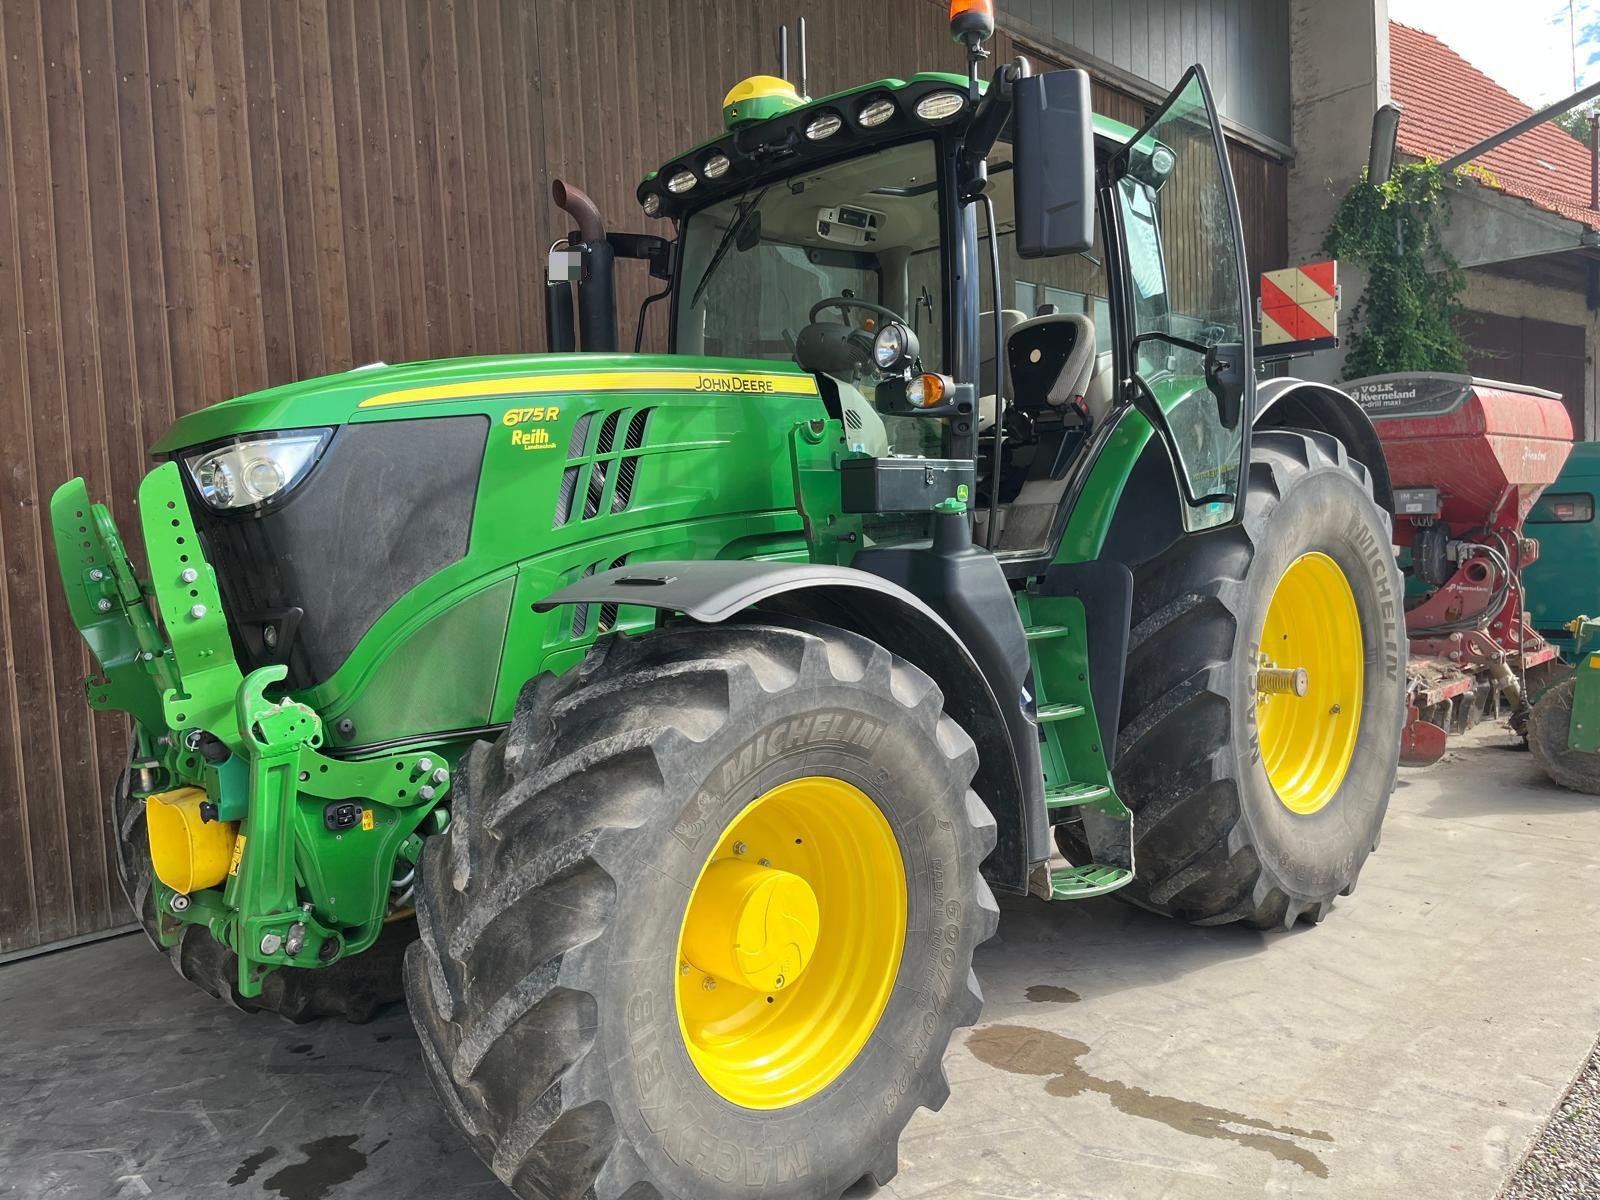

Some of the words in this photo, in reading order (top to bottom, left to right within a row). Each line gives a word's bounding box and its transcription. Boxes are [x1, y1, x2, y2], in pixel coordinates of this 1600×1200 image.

[1361, 383, 1394, 393] VOLK
[1361, 389, 1416, 401] Kverneland
[1383, 399, 1401, 407] maxi
[512, 428, 549, 446] Reith
[1355, 526, 1397, 683] MICHELIN
[721, 713, 885, 795] MICHELIN
